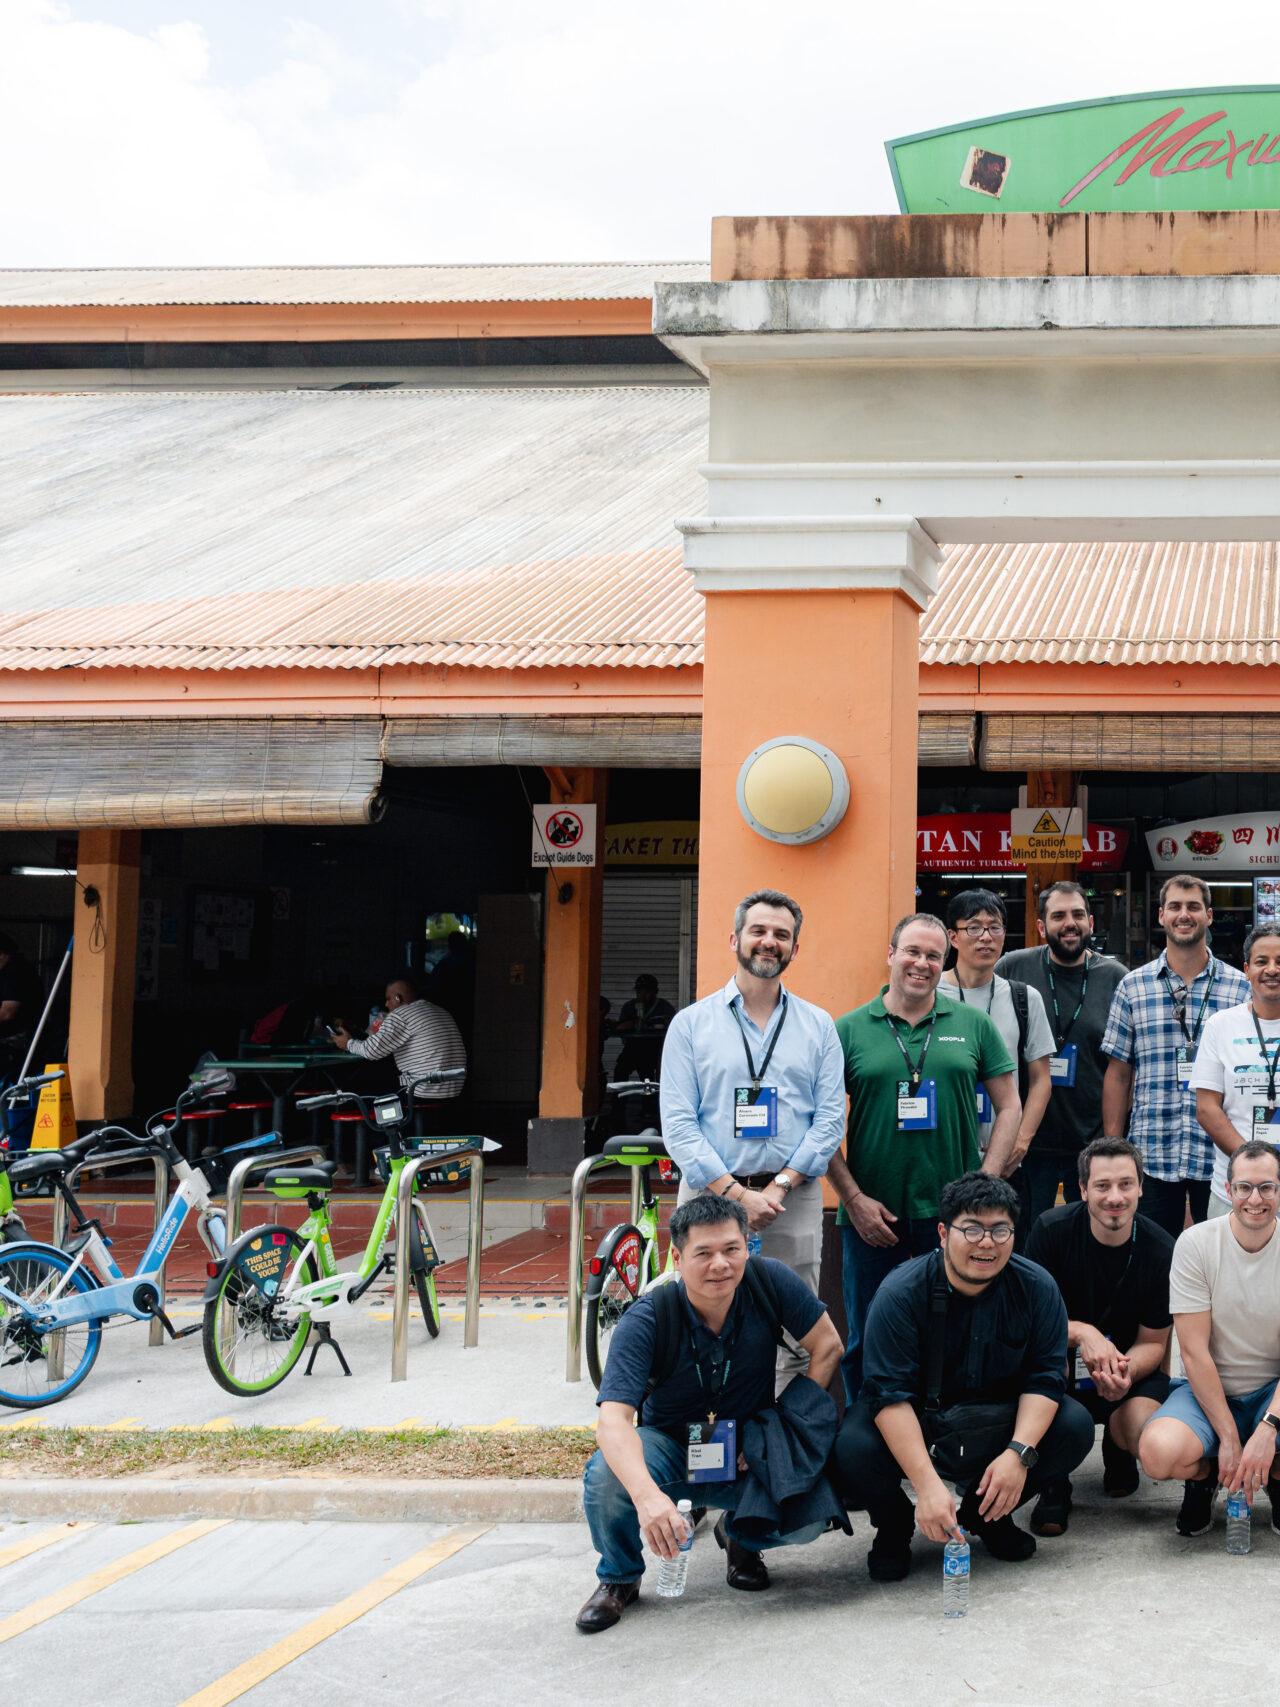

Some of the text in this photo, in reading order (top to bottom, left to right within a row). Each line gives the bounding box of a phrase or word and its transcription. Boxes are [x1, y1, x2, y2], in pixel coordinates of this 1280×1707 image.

[603, 836, 699, 856] AKET TH
[1028, 836, 1066, 847] Caution
[533, 851, 594, 865] Except Guide Dogs
[1012, 848, 1082, 861] Mind the step
[923, 859, 976, 867] AUTHENTIC
[155, 1216, 178, 1255] HelloRide
[245, 1247, 282, 1267] THIS SPACE
[250, 1256, 281, 1273] COULD BE
[258, 1265, 280, 1279] YOURS
